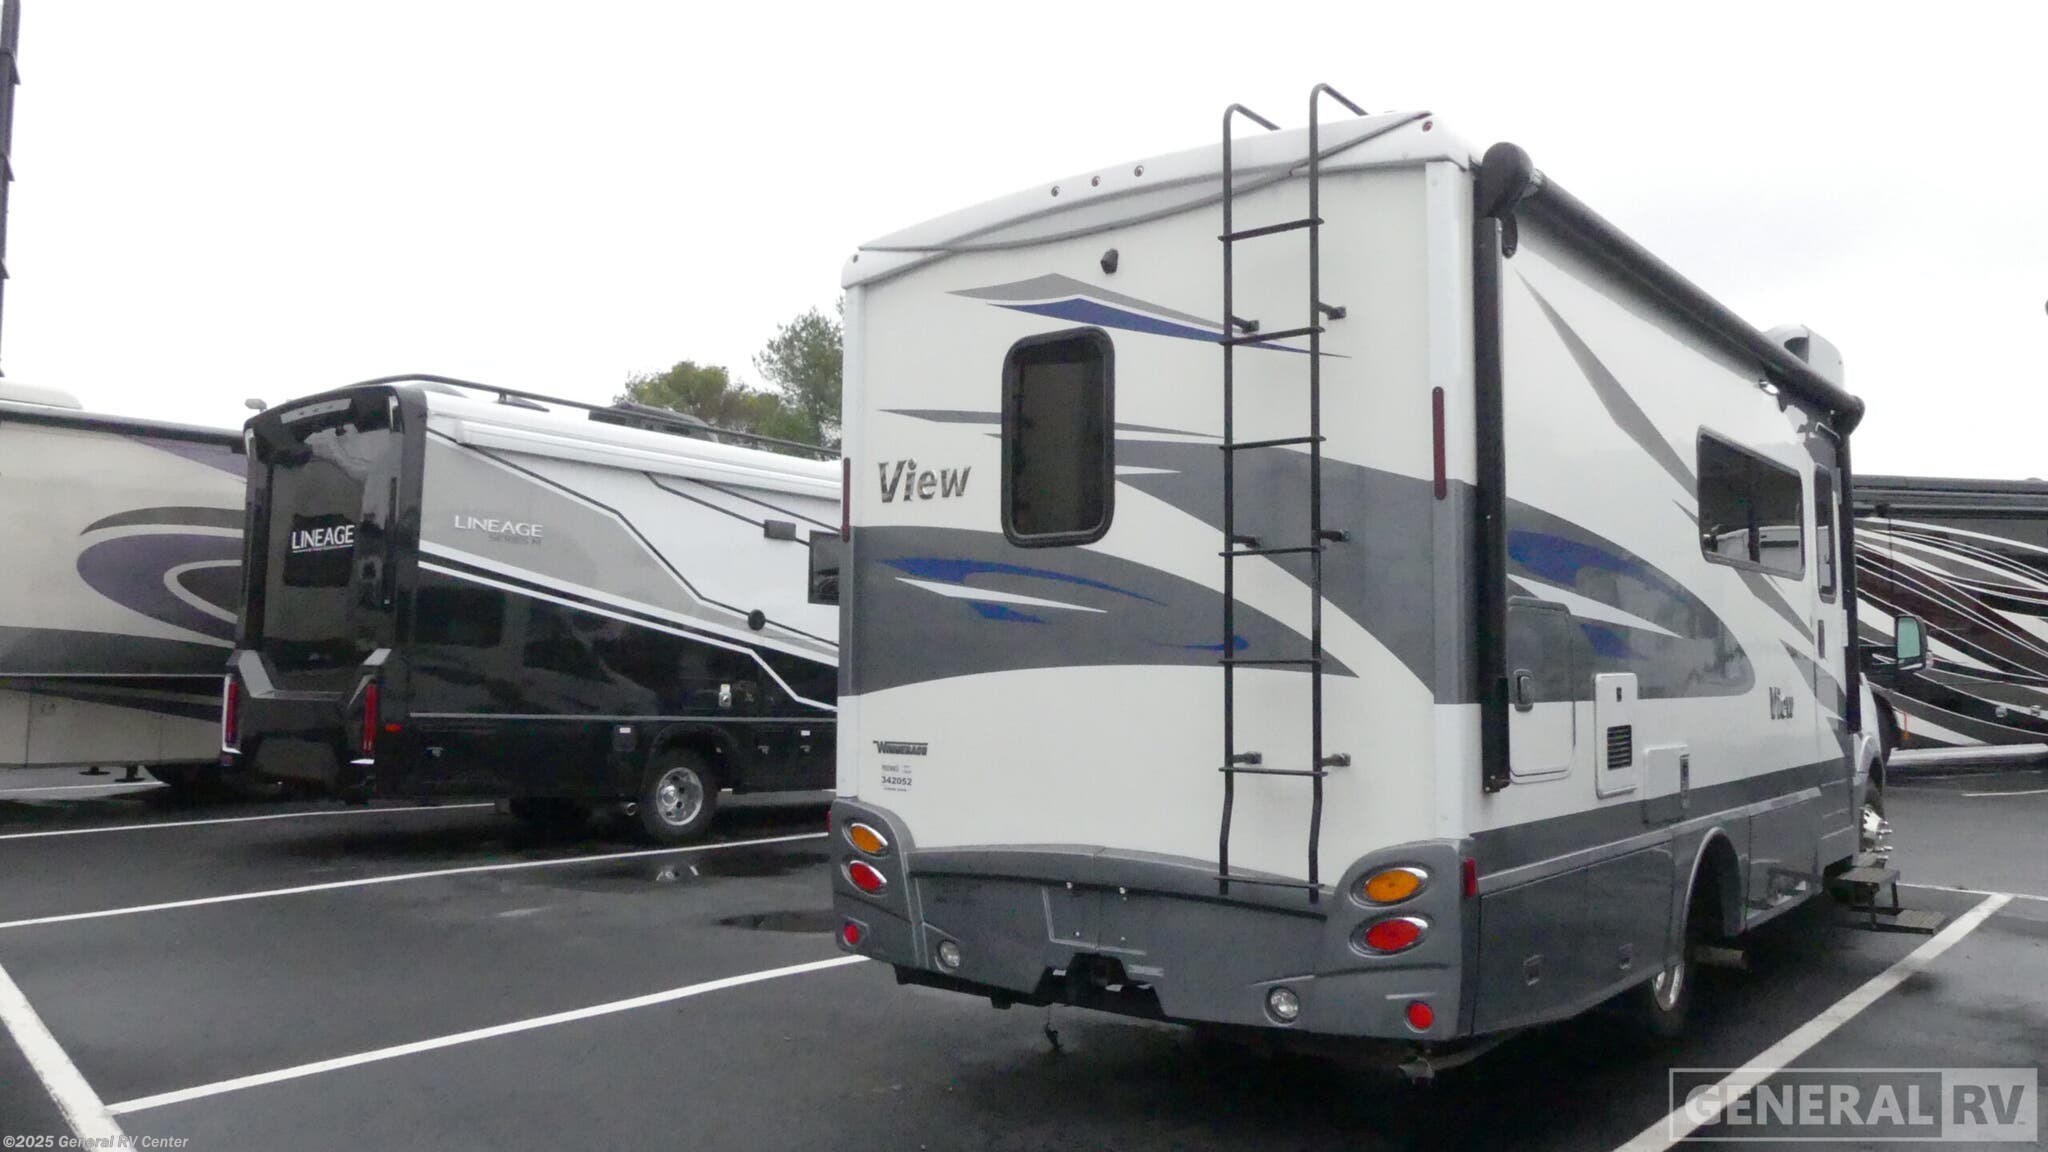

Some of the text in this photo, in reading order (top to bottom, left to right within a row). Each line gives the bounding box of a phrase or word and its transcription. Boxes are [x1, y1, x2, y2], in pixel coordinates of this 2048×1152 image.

[878, 458, 972, 503] View
[291, 525, 355, 549] LINEAGE
[454, 515, 544, 537] LINEAGE
[881, 776, 912, 786] 342052
